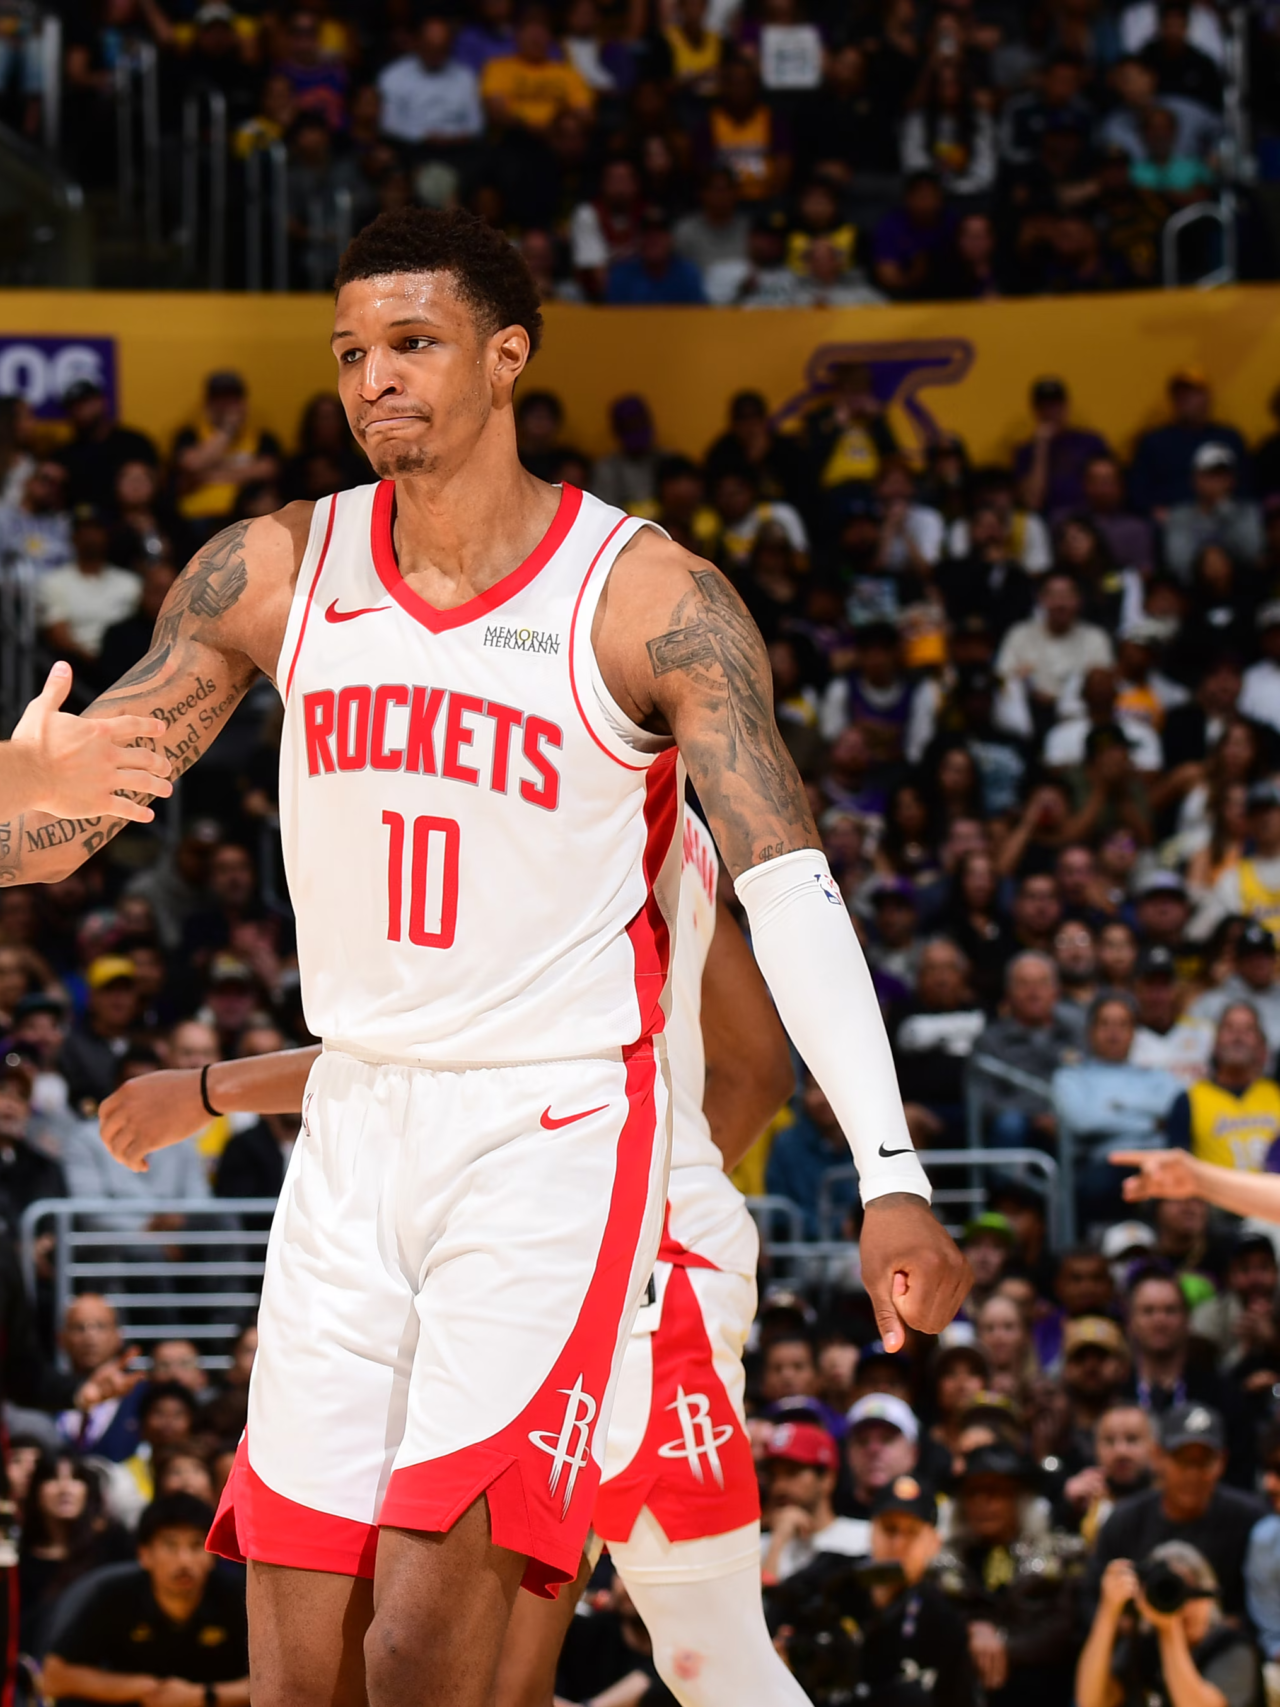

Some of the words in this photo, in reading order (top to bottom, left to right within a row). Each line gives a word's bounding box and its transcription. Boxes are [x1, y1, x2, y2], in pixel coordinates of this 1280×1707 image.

[483, 633, 561, 655] HERMANN
[485, 625, 560, 645] MEMORIAL
[150, 677, 217, 731] Breeds
[163, 723, 202, 762] And
[302, 684, 564, 813] ROCKETS
[382, 810, 460, 950] 10
